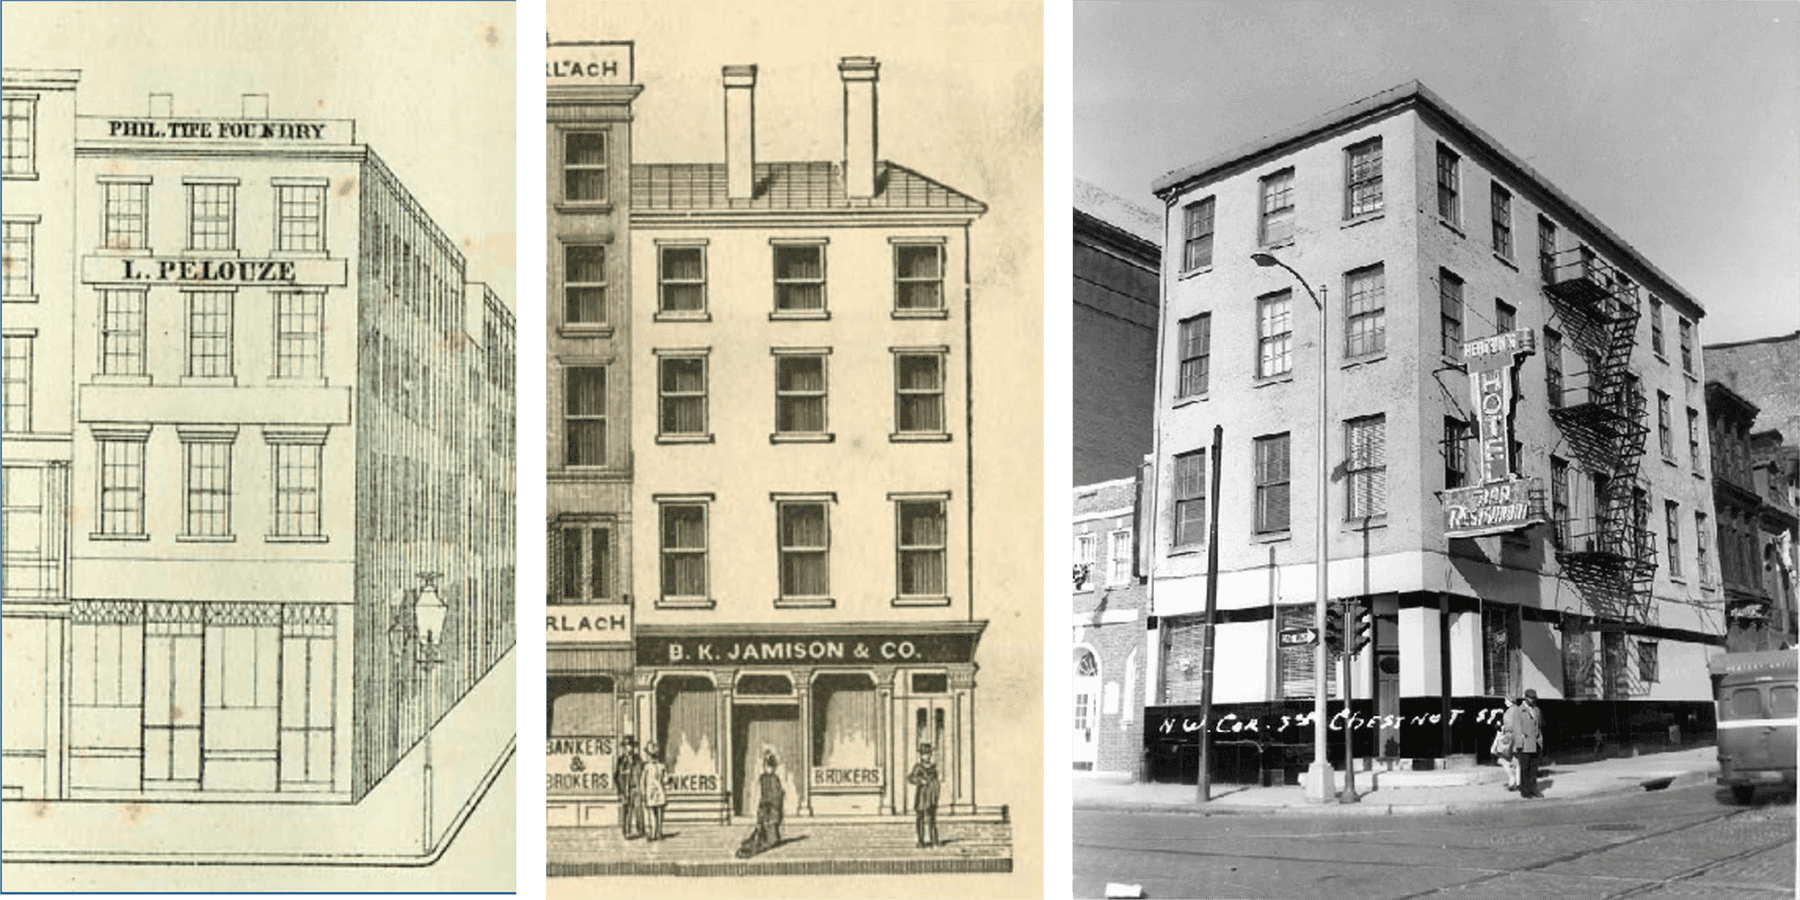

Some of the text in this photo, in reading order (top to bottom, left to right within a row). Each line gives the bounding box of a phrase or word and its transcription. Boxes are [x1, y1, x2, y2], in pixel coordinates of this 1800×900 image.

[108, 120, 325, 140] PHIL. TYPE FOUNDRY
[122, 259, 297, 282] L. PELOUZE
[1482, 370, 1504, 482] HOTEL
[668, 642, 922, 660] B. K. JAMISON & CO.
[570, 756, 586, 772] &
[814, 768, 880, 784] BROKERS
